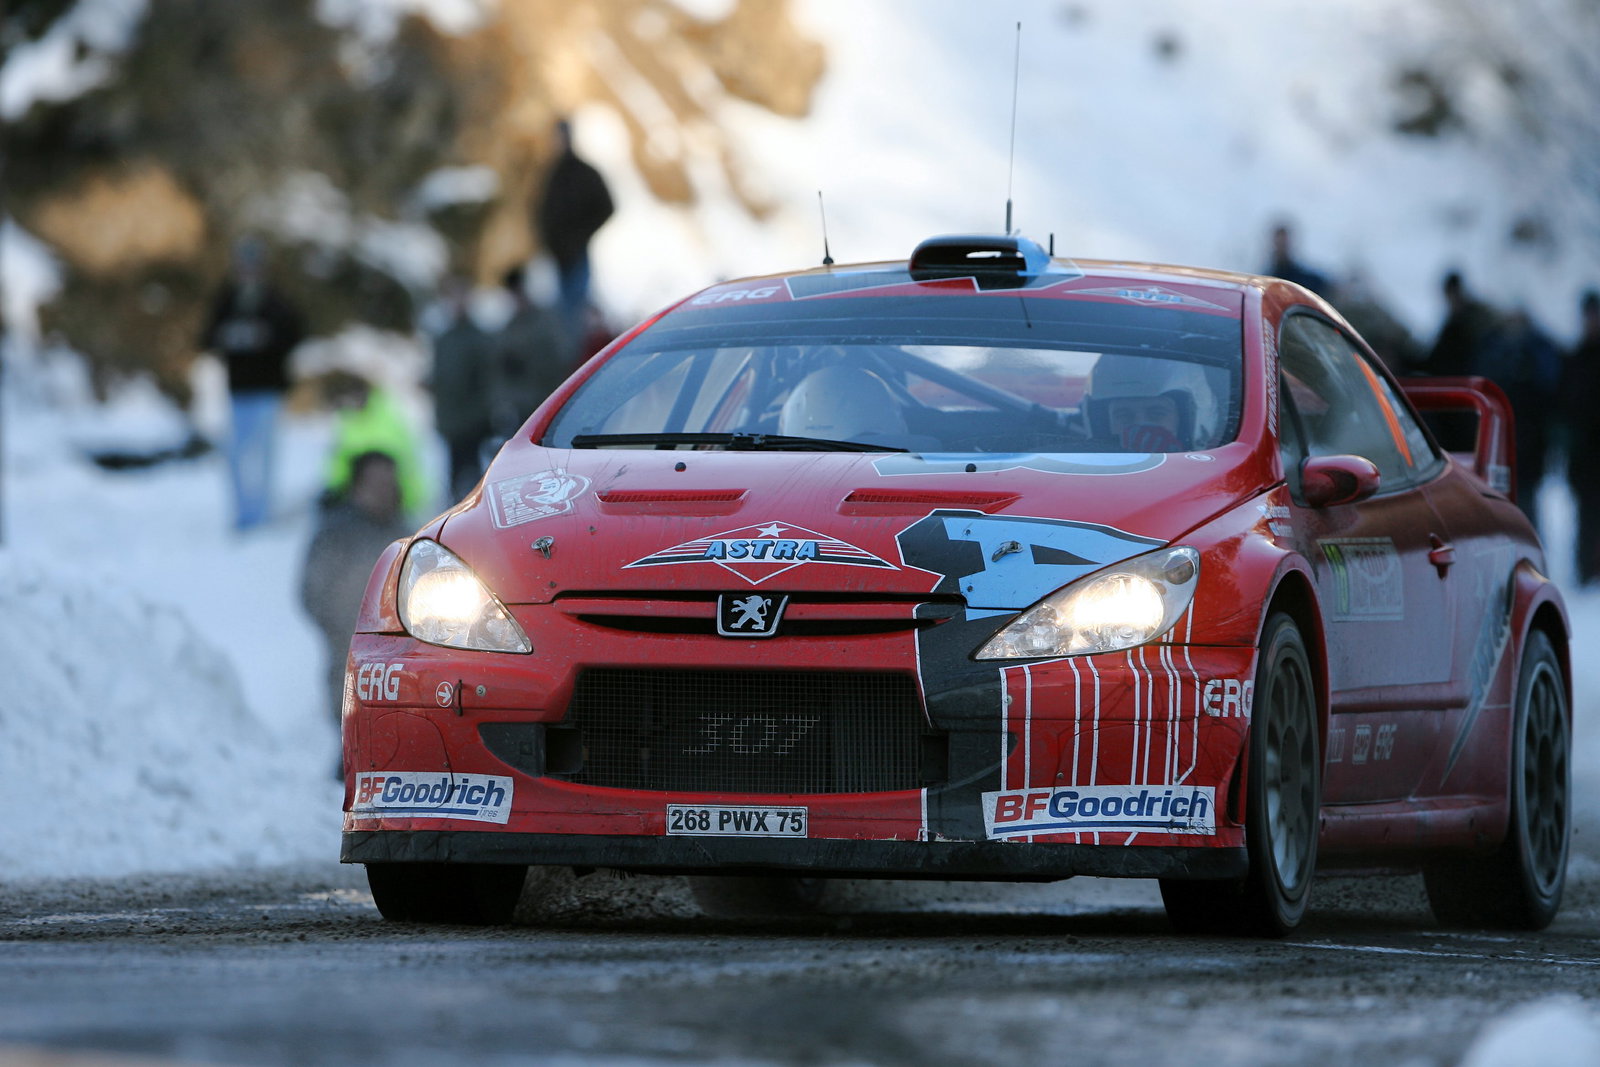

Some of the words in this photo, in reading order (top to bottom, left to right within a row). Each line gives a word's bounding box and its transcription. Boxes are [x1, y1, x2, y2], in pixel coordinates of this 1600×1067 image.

[691, 286, 782, 306] ERG
[703, 539, 820, 561] ASTRA
[357, 663, 405, 701] ERG
[1203, 679, 1254, 718] ERG
[358, 776, 506, 807] BFGoodrich
[994, 790, 1208, 824] BFGoodrich
[671, 808, 710, 831] 268
[719, 809, 770, 832] PWX
[777, 811, 804, 833] 75
